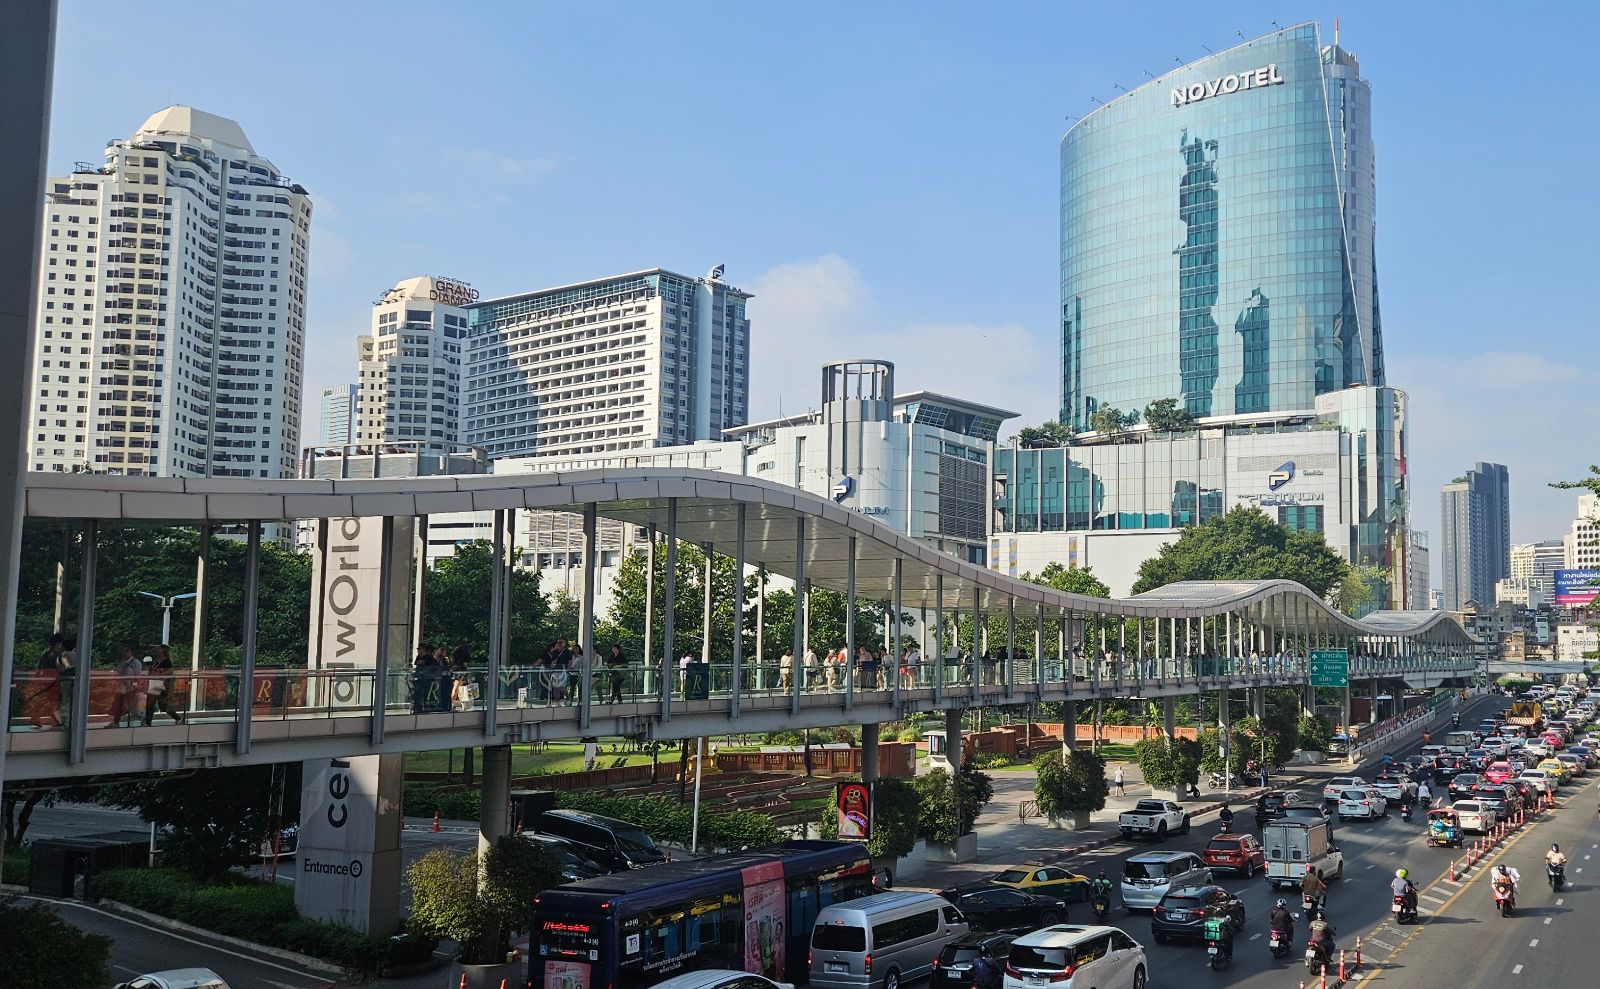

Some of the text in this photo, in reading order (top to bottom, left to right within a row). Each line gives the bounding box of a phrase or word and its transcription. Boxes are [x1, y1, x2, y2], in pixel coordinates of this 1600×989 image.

[1171, 64, 1284, 107] NOVOTEL
[436, 281, 480, 299] GRAND
[257, 679, 272, 698] R
[426, 681, 440, 701] R
[693, 674, 702, 690] R
[304, 858, 348, 875] Entrance
